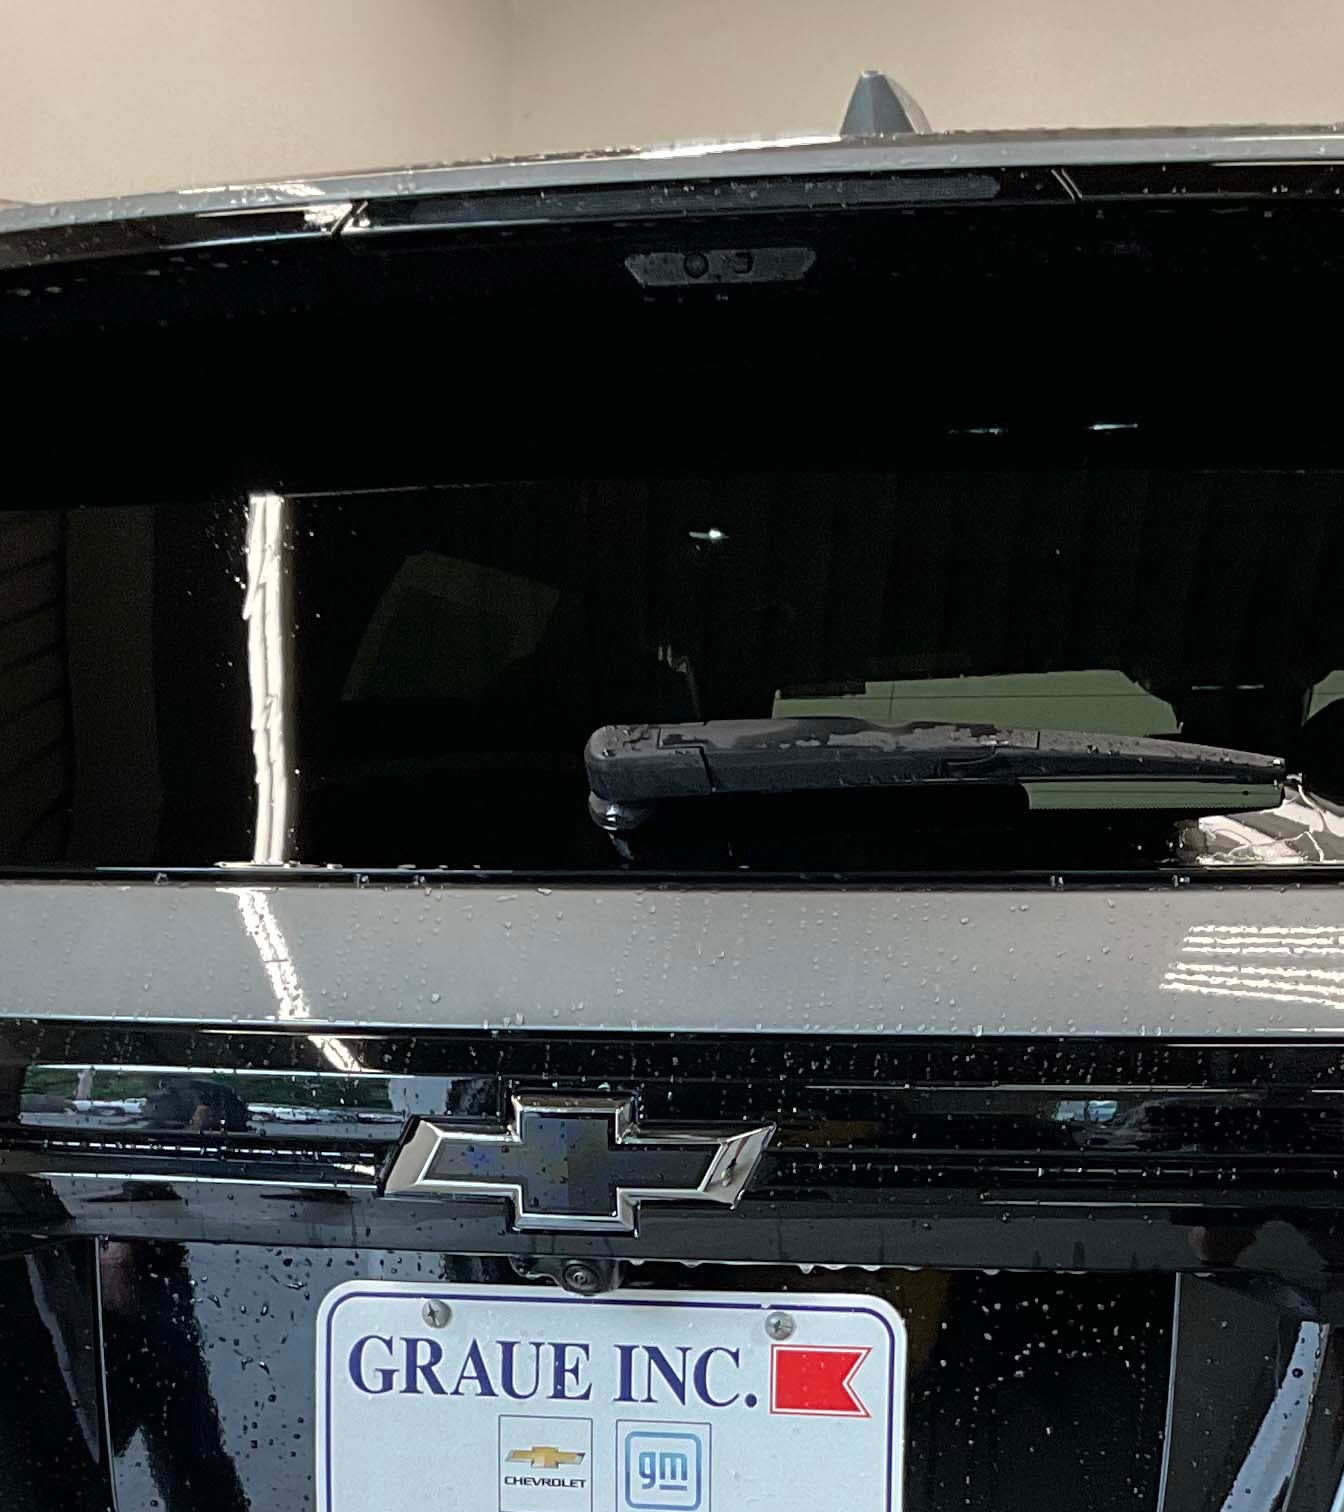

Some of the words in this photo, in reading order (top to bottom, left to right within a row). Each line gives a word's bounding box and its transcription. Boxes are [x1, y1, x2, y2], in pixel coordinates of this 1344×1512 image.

[347, 1333, 593, 1402] GRAUE
[613, 1342, 758, 1409] INC.
[504, 1475, 587, 1490] CHEVROLET
[638, 1451, 689, 1492] gm
